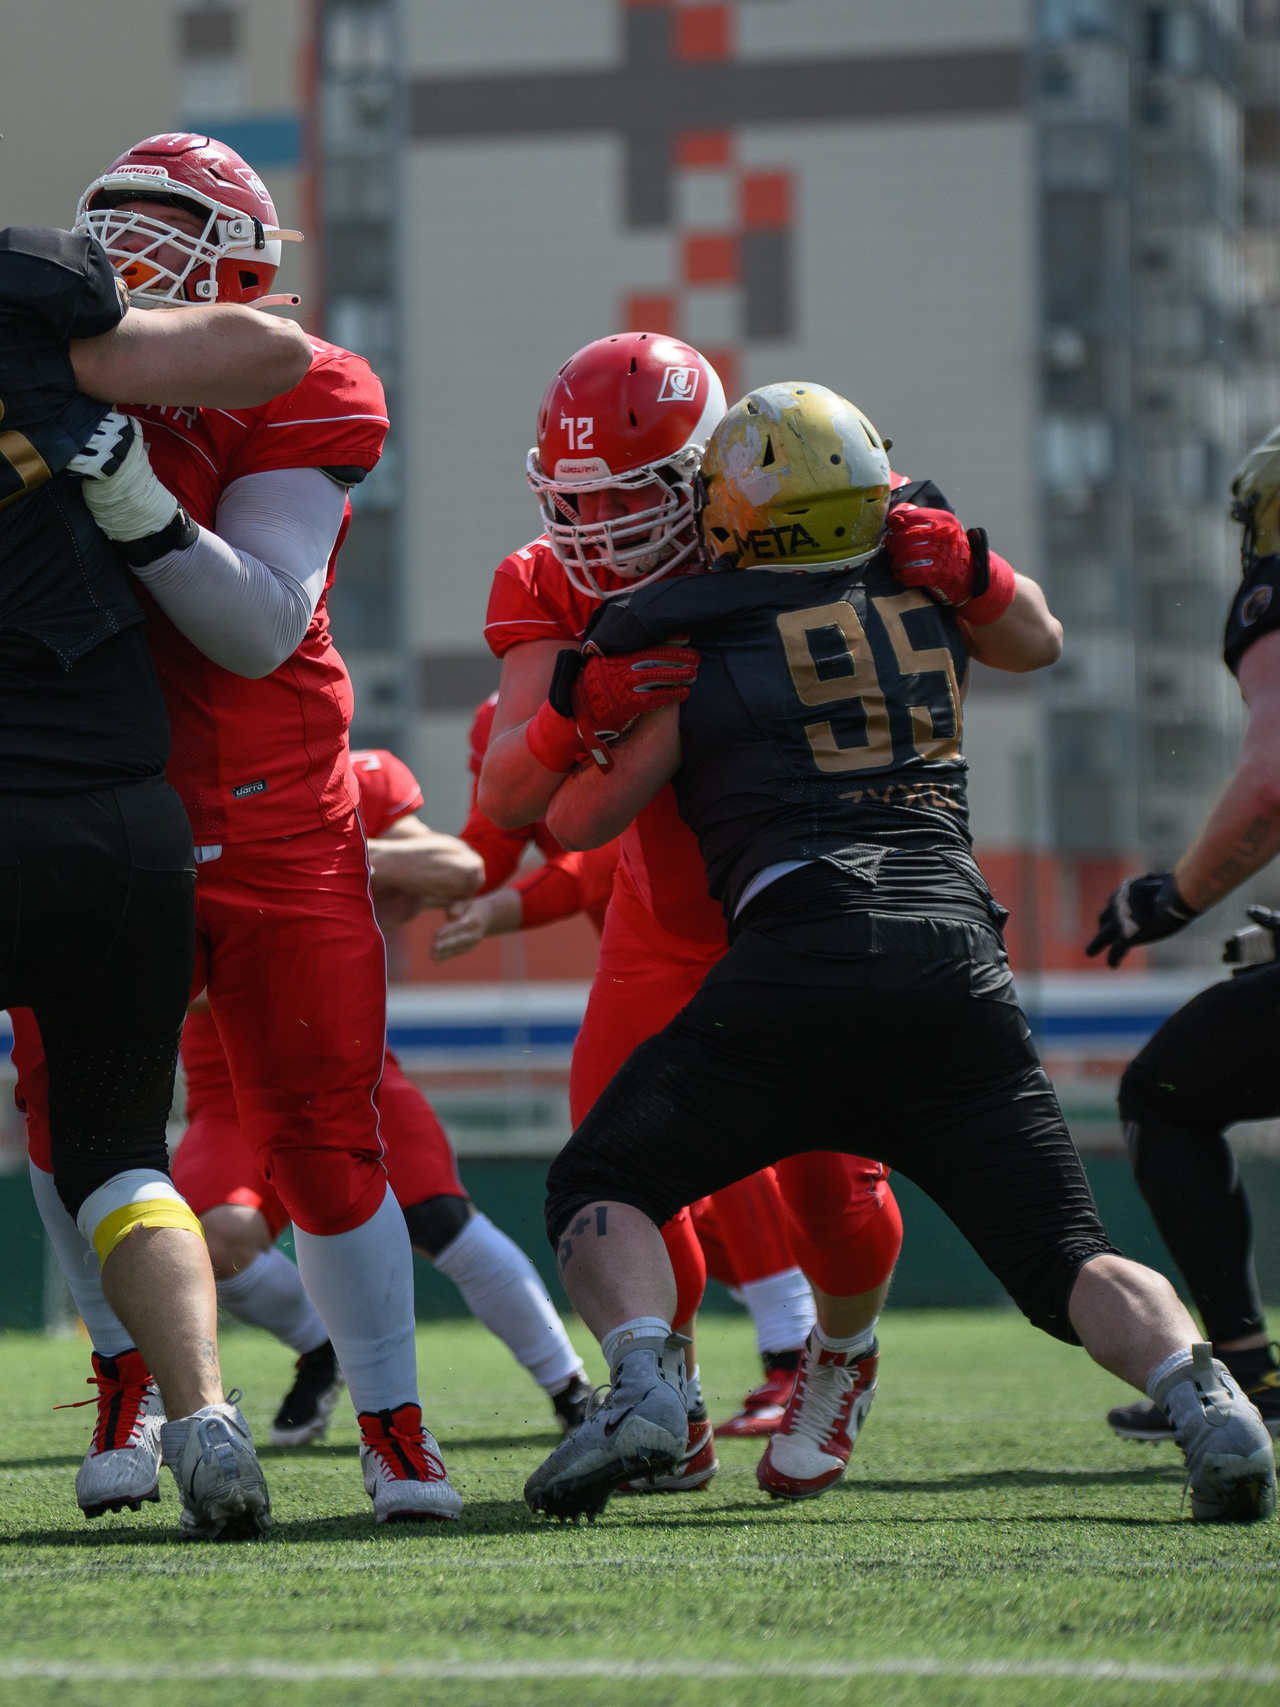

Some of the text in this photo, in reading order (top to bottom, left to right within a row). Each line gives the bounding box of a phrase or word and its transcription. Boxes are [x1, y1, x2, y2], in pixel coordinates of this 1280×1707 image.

[560, 416, 594, 450] 72
[733, 522, 821, 559] META
[776, 588, 963, 773] 95
